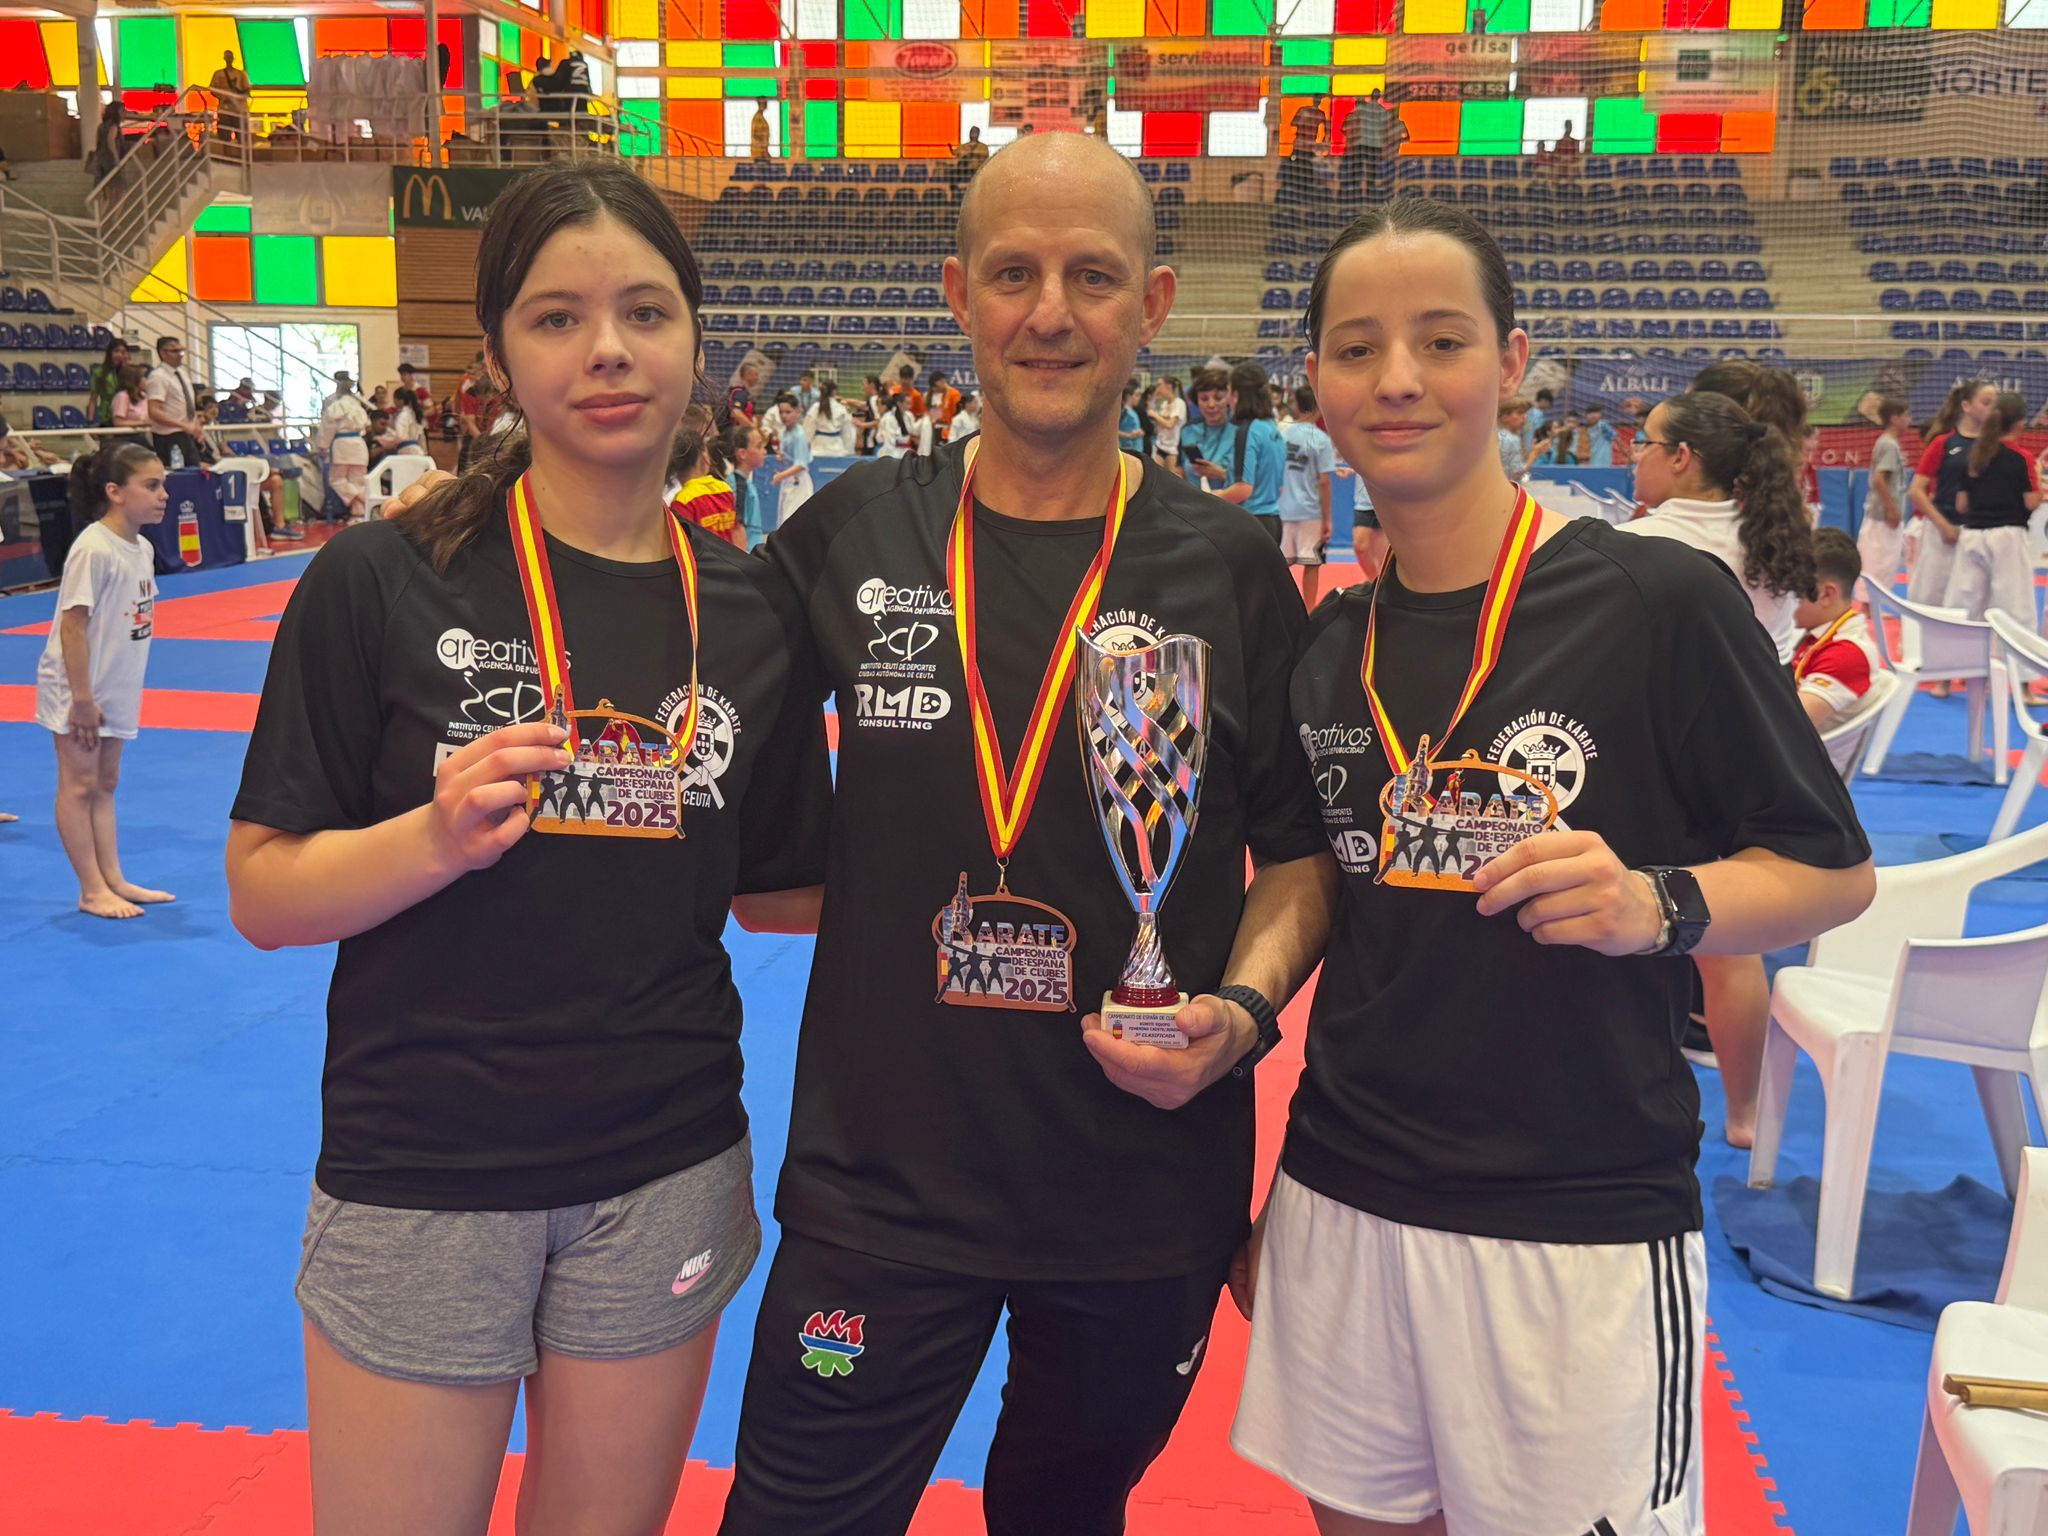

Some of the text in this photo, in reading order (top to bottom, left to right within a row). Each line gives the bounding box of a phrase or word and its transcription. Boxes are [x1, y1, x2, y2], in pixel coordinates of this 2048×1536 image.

[461, 206, 489, 222] VAL
[1139, 613, 1157, 631] DE
[478, 661, 514, 672] AGENCIA
[515, 664, 525, 673] DE
[906, 664, 937, 672] DEPORTES
[706, 686, 720, 701] DE
[858, 718, 933, 731] CONSULTING
[1487, 708, 1598, 761] FEDERACIÓN DE KÁRATE
[596, 766, 675, 780] CAMPEONATO
[618, 789, 676, 801] DE CLUBES
[682, 790, 712, 808] CEUTA
[606, 801, 679, 829] 2025
[1455, 819, 1543, 834] CAMPEONATO
[1477, 842, 1492, 853] DE
[995, 946, 1066, 960] CAMPEONATO
[1015, 967, 1066, 979] DE CLUBES
[1004, 977, 1069, 1004] 2025
[680, 1249, 712, 1280] NIKE
